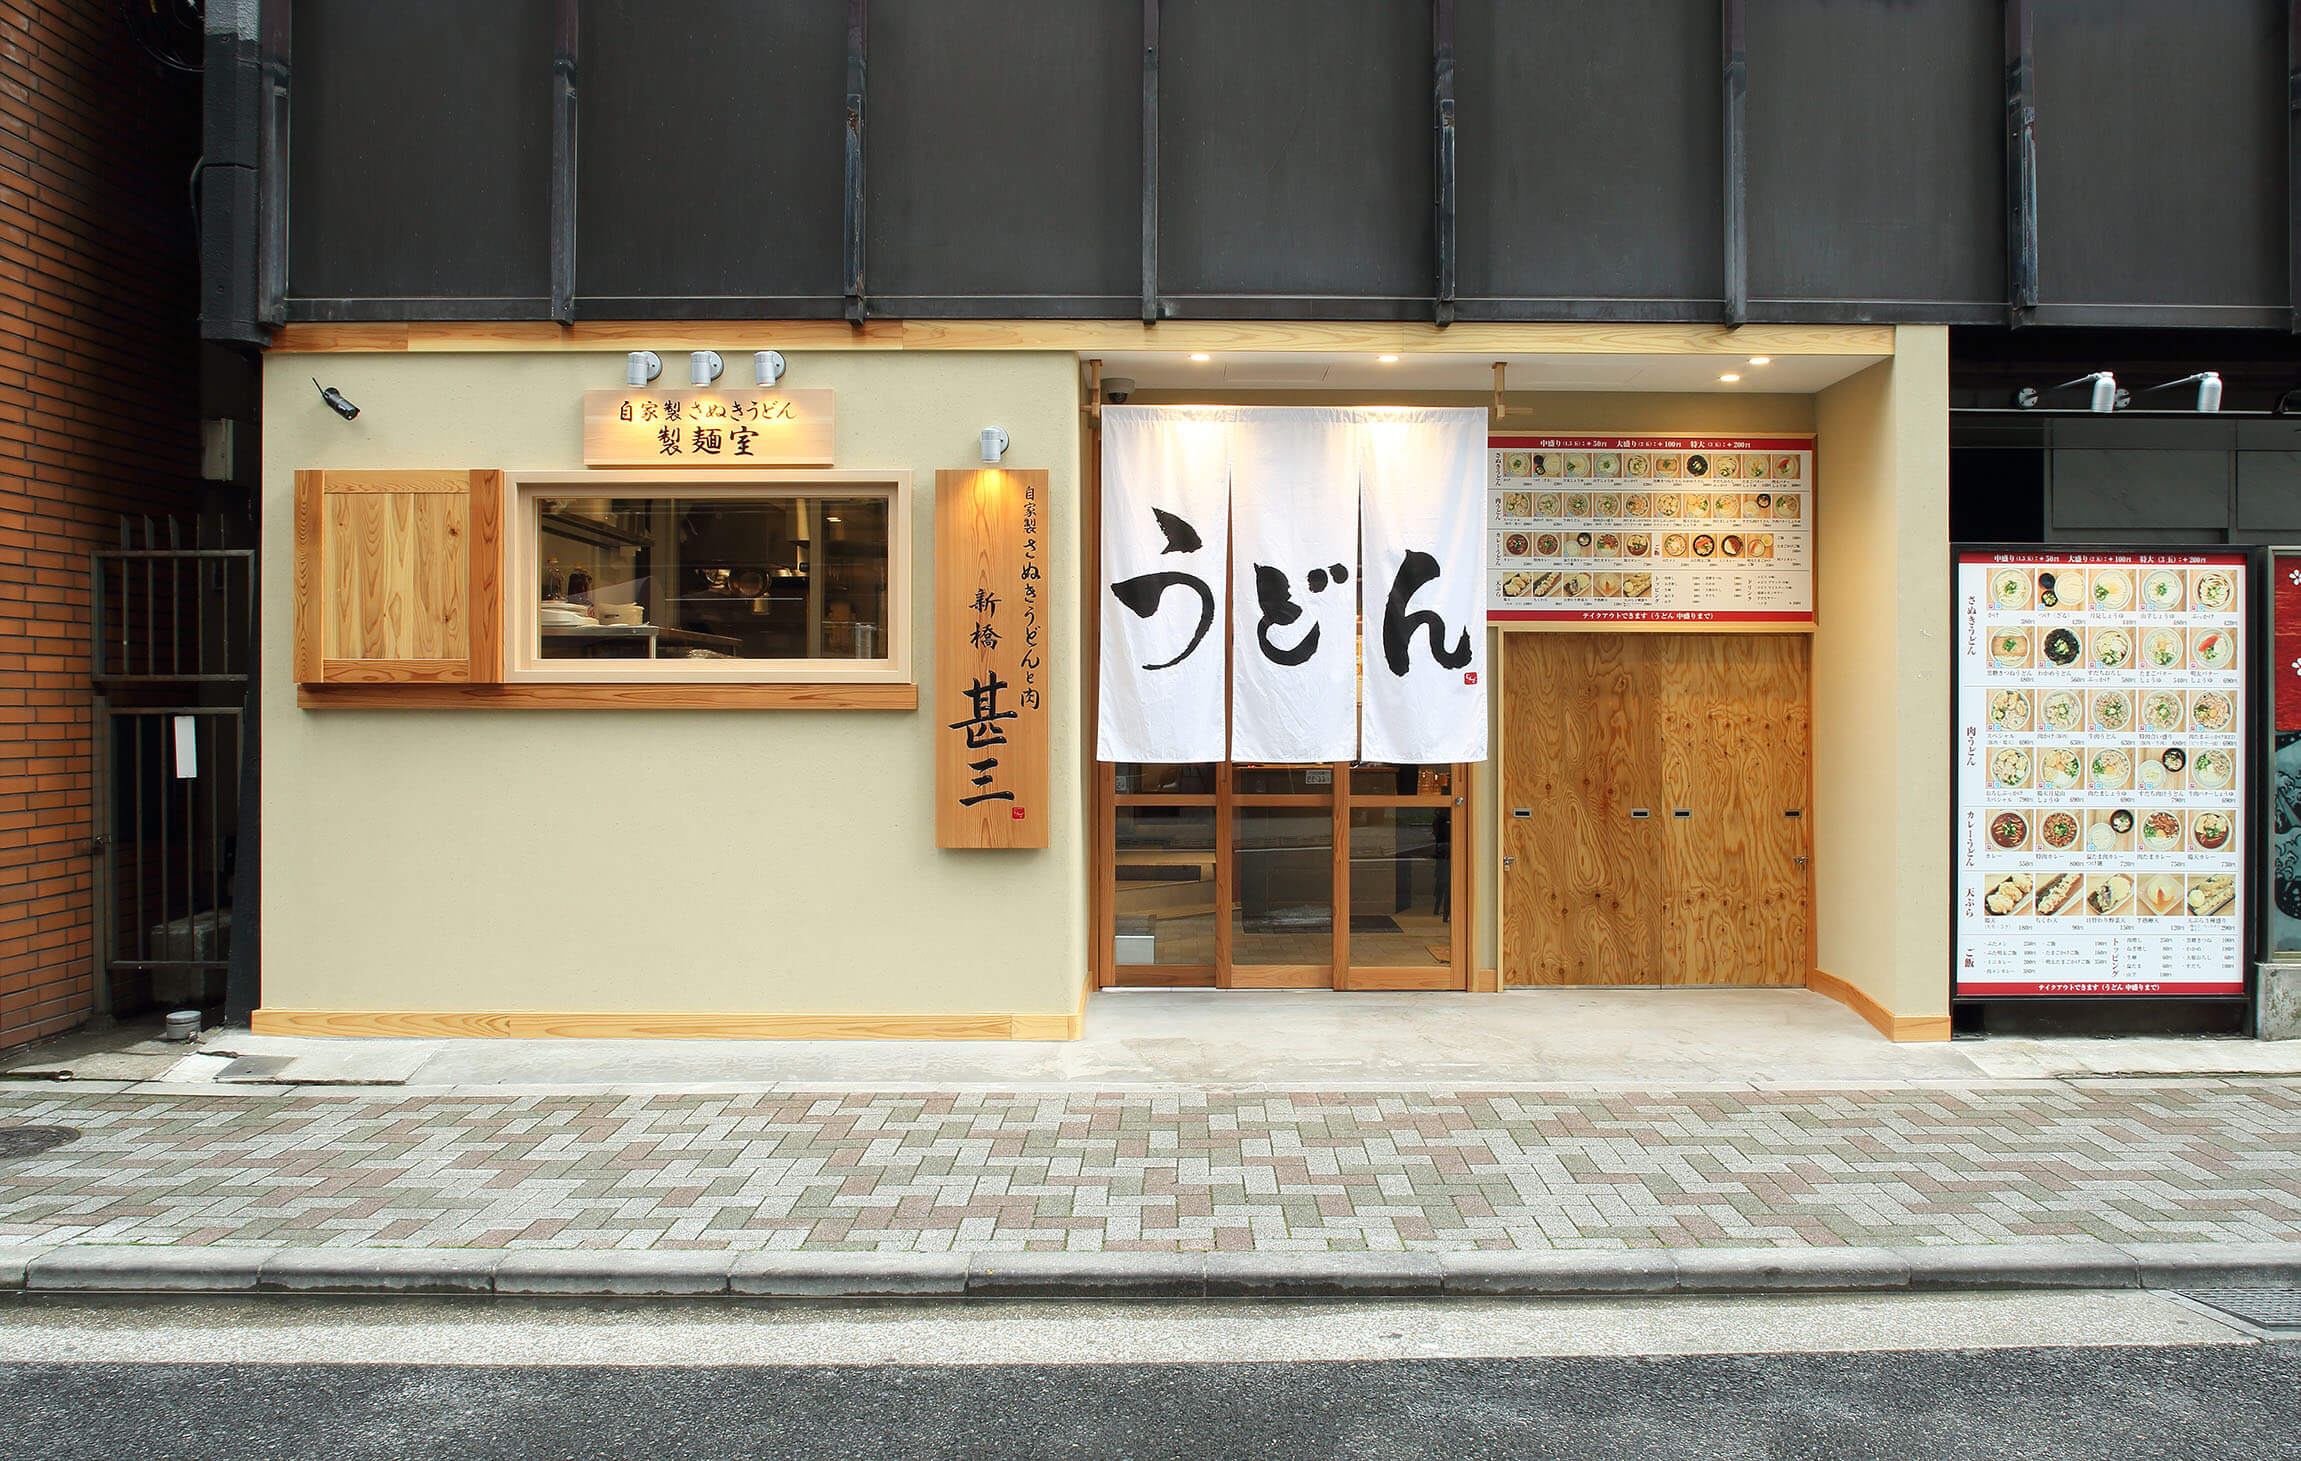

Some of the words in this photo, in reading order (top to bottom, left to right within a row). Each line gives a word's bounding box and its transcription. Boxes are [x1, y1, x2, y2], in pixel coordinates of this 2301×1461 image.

[658, 425, 760, 456] 製麺室
[969, 588, 1002, 650] 新橋
[1966, 595, 1977, 656] さぬきうどん
[949, 670, 1018, 808] 甚三
[1966, 726, 1976, 766] 肉うどん
[1965, 810, 1975, 867] カレーうどん
[1965, 888, 1976, 918] 天ぷら
[1964, 948, 1975, 968] ご飯
